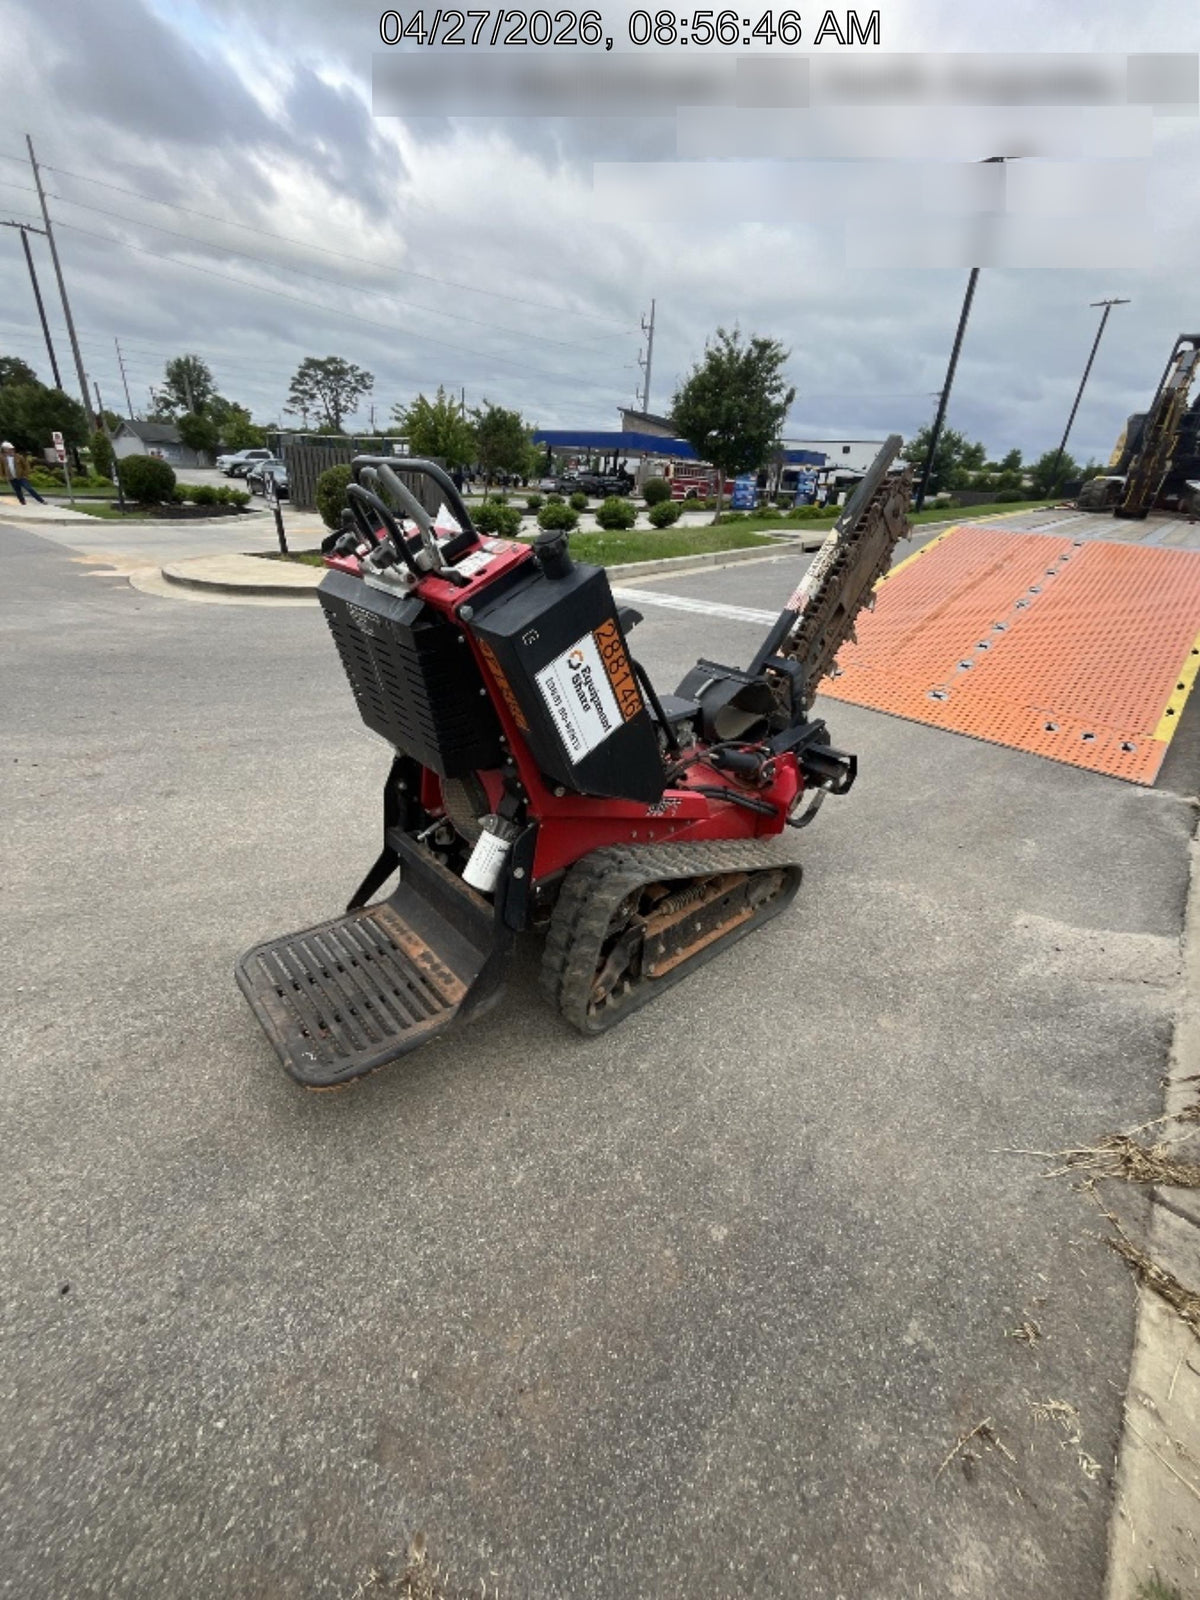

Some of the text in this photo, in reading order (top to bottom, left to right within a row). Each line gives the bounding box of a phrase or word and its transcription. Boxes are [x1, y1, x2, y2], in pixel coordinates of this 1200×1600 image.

[572, 673, 592, 713] Share
[581, 666, 612, 733] Equipment
[595, 623, 641, 717] 288146
